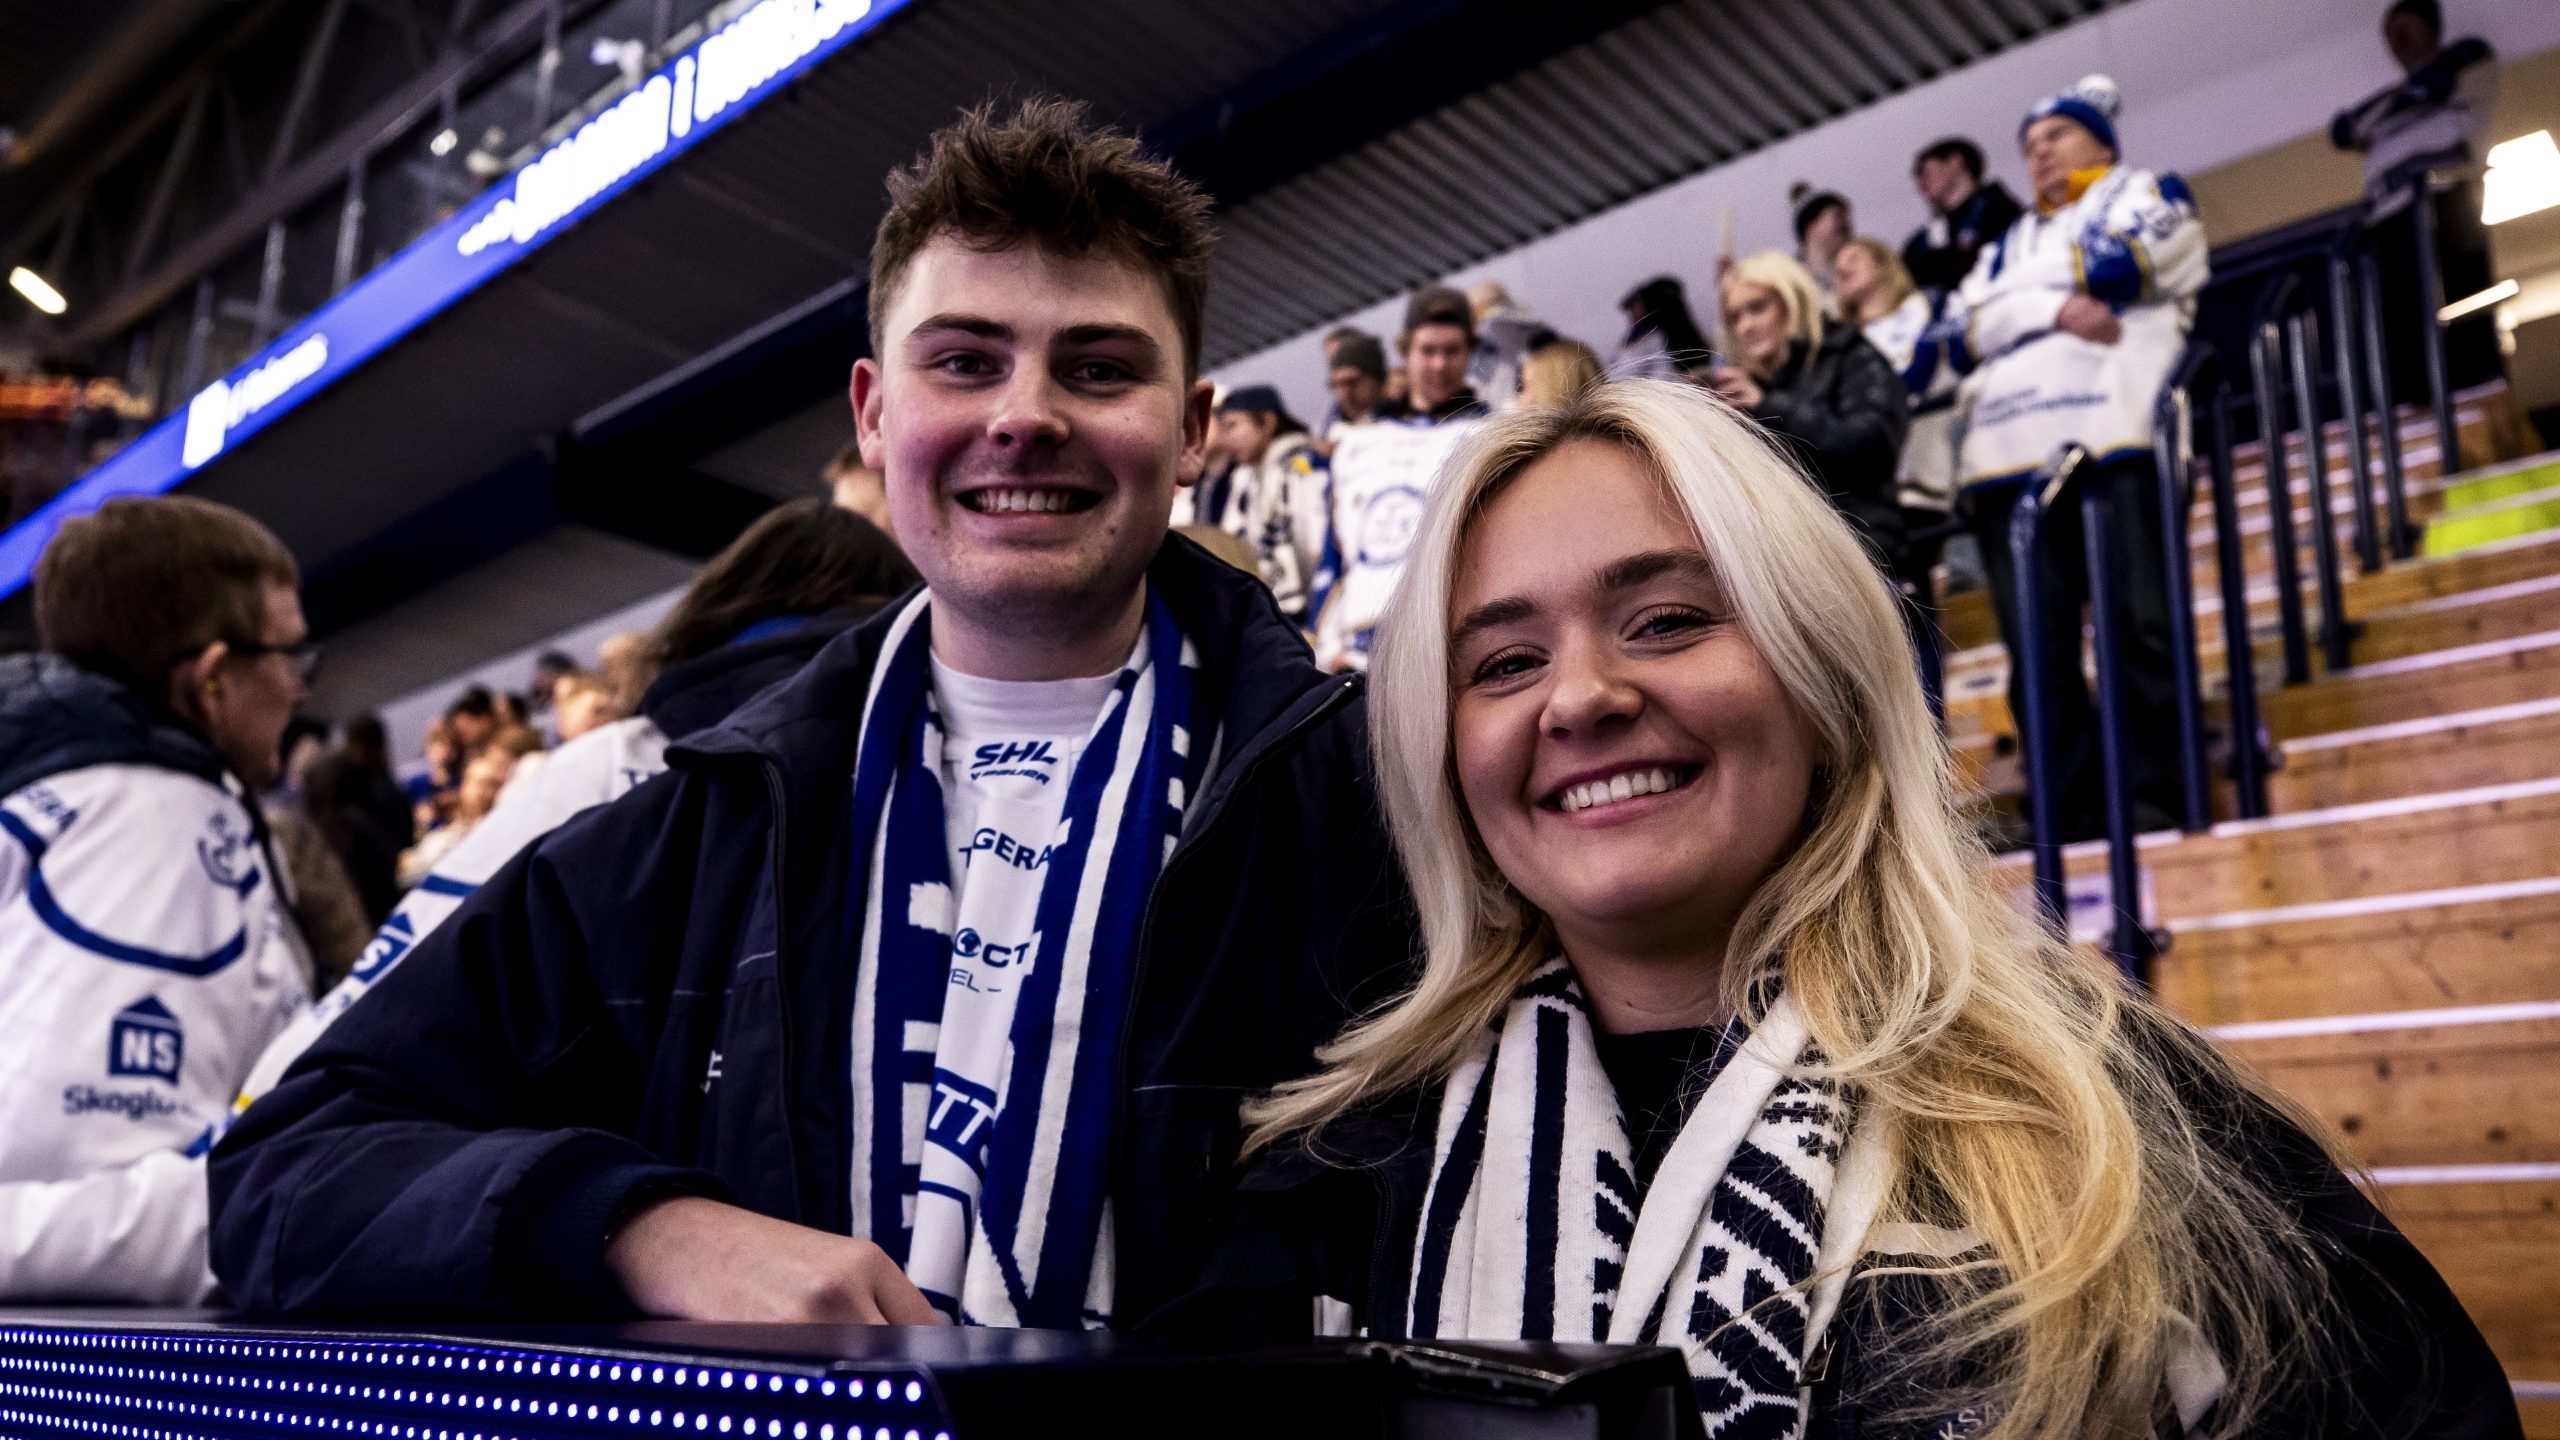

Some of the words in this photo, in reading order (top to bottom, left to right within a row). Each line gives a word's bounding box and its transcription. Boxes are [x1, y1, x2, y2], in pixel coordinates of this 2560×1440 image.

[970, 741, 1058, 769] SHL
[950, 968, 980, 993] EL
[121, 1027, 177, 1073] NS
[928, 1082, 995, 1168] TT
